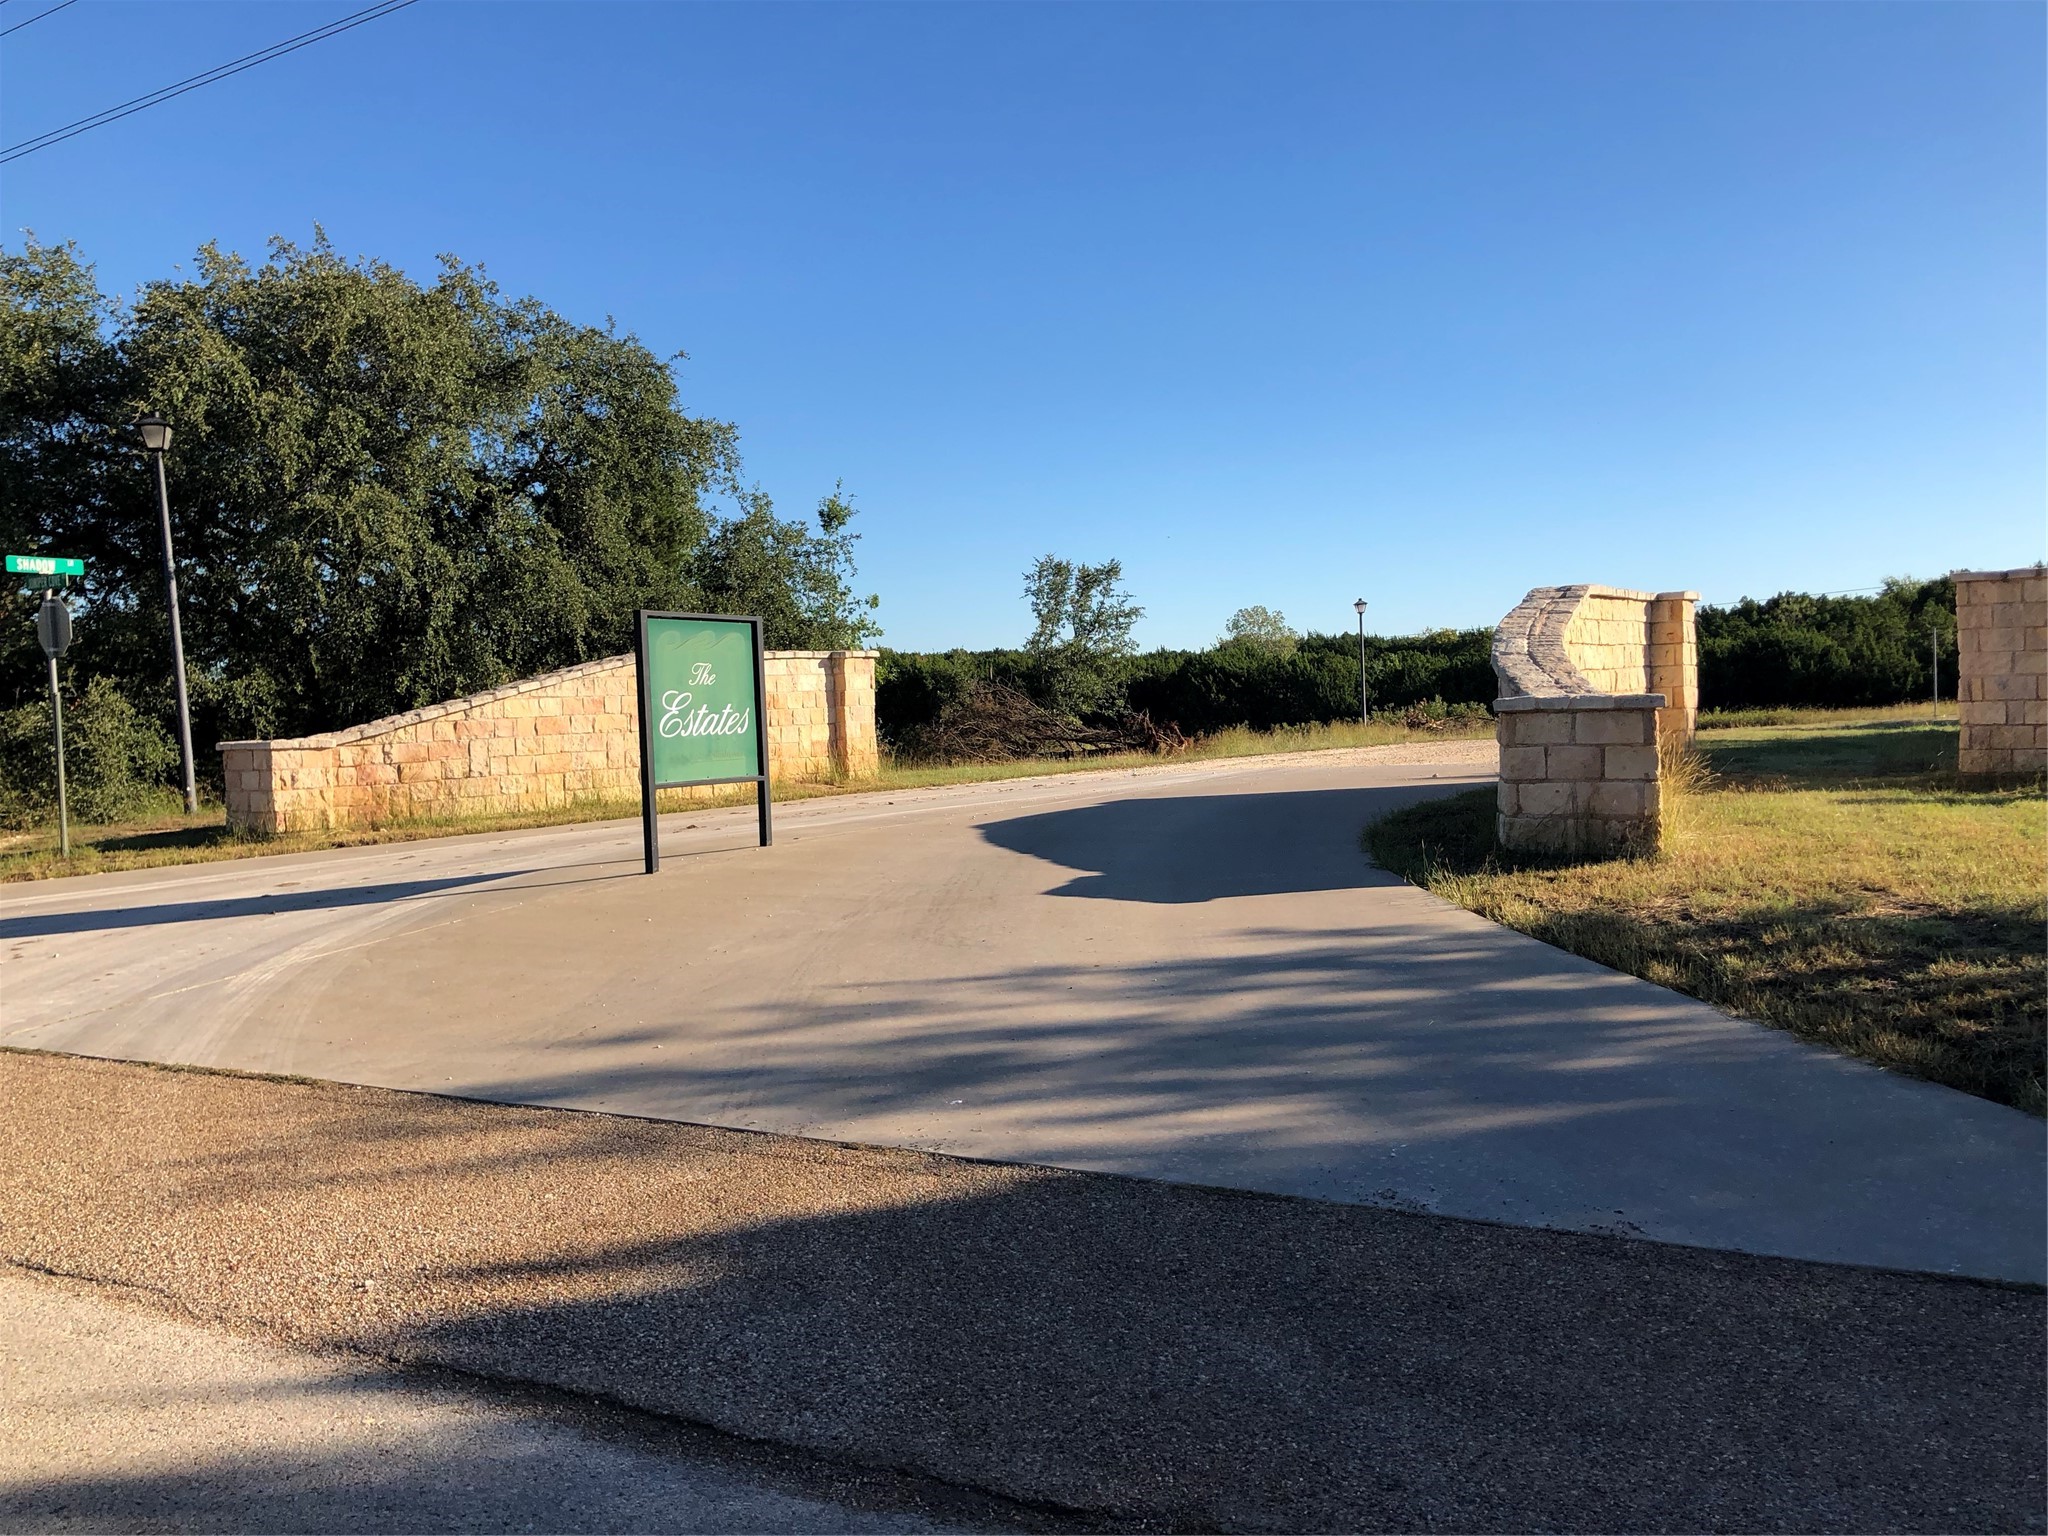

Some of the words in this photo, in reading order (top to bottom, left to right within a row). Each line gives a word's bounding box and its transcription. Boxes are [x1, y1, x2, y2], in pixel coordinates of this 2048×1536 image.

[16, 557, 56, 573] SHADOW
[688, 662, 717, 686] The
[659, 690, 750, 738] Estates
